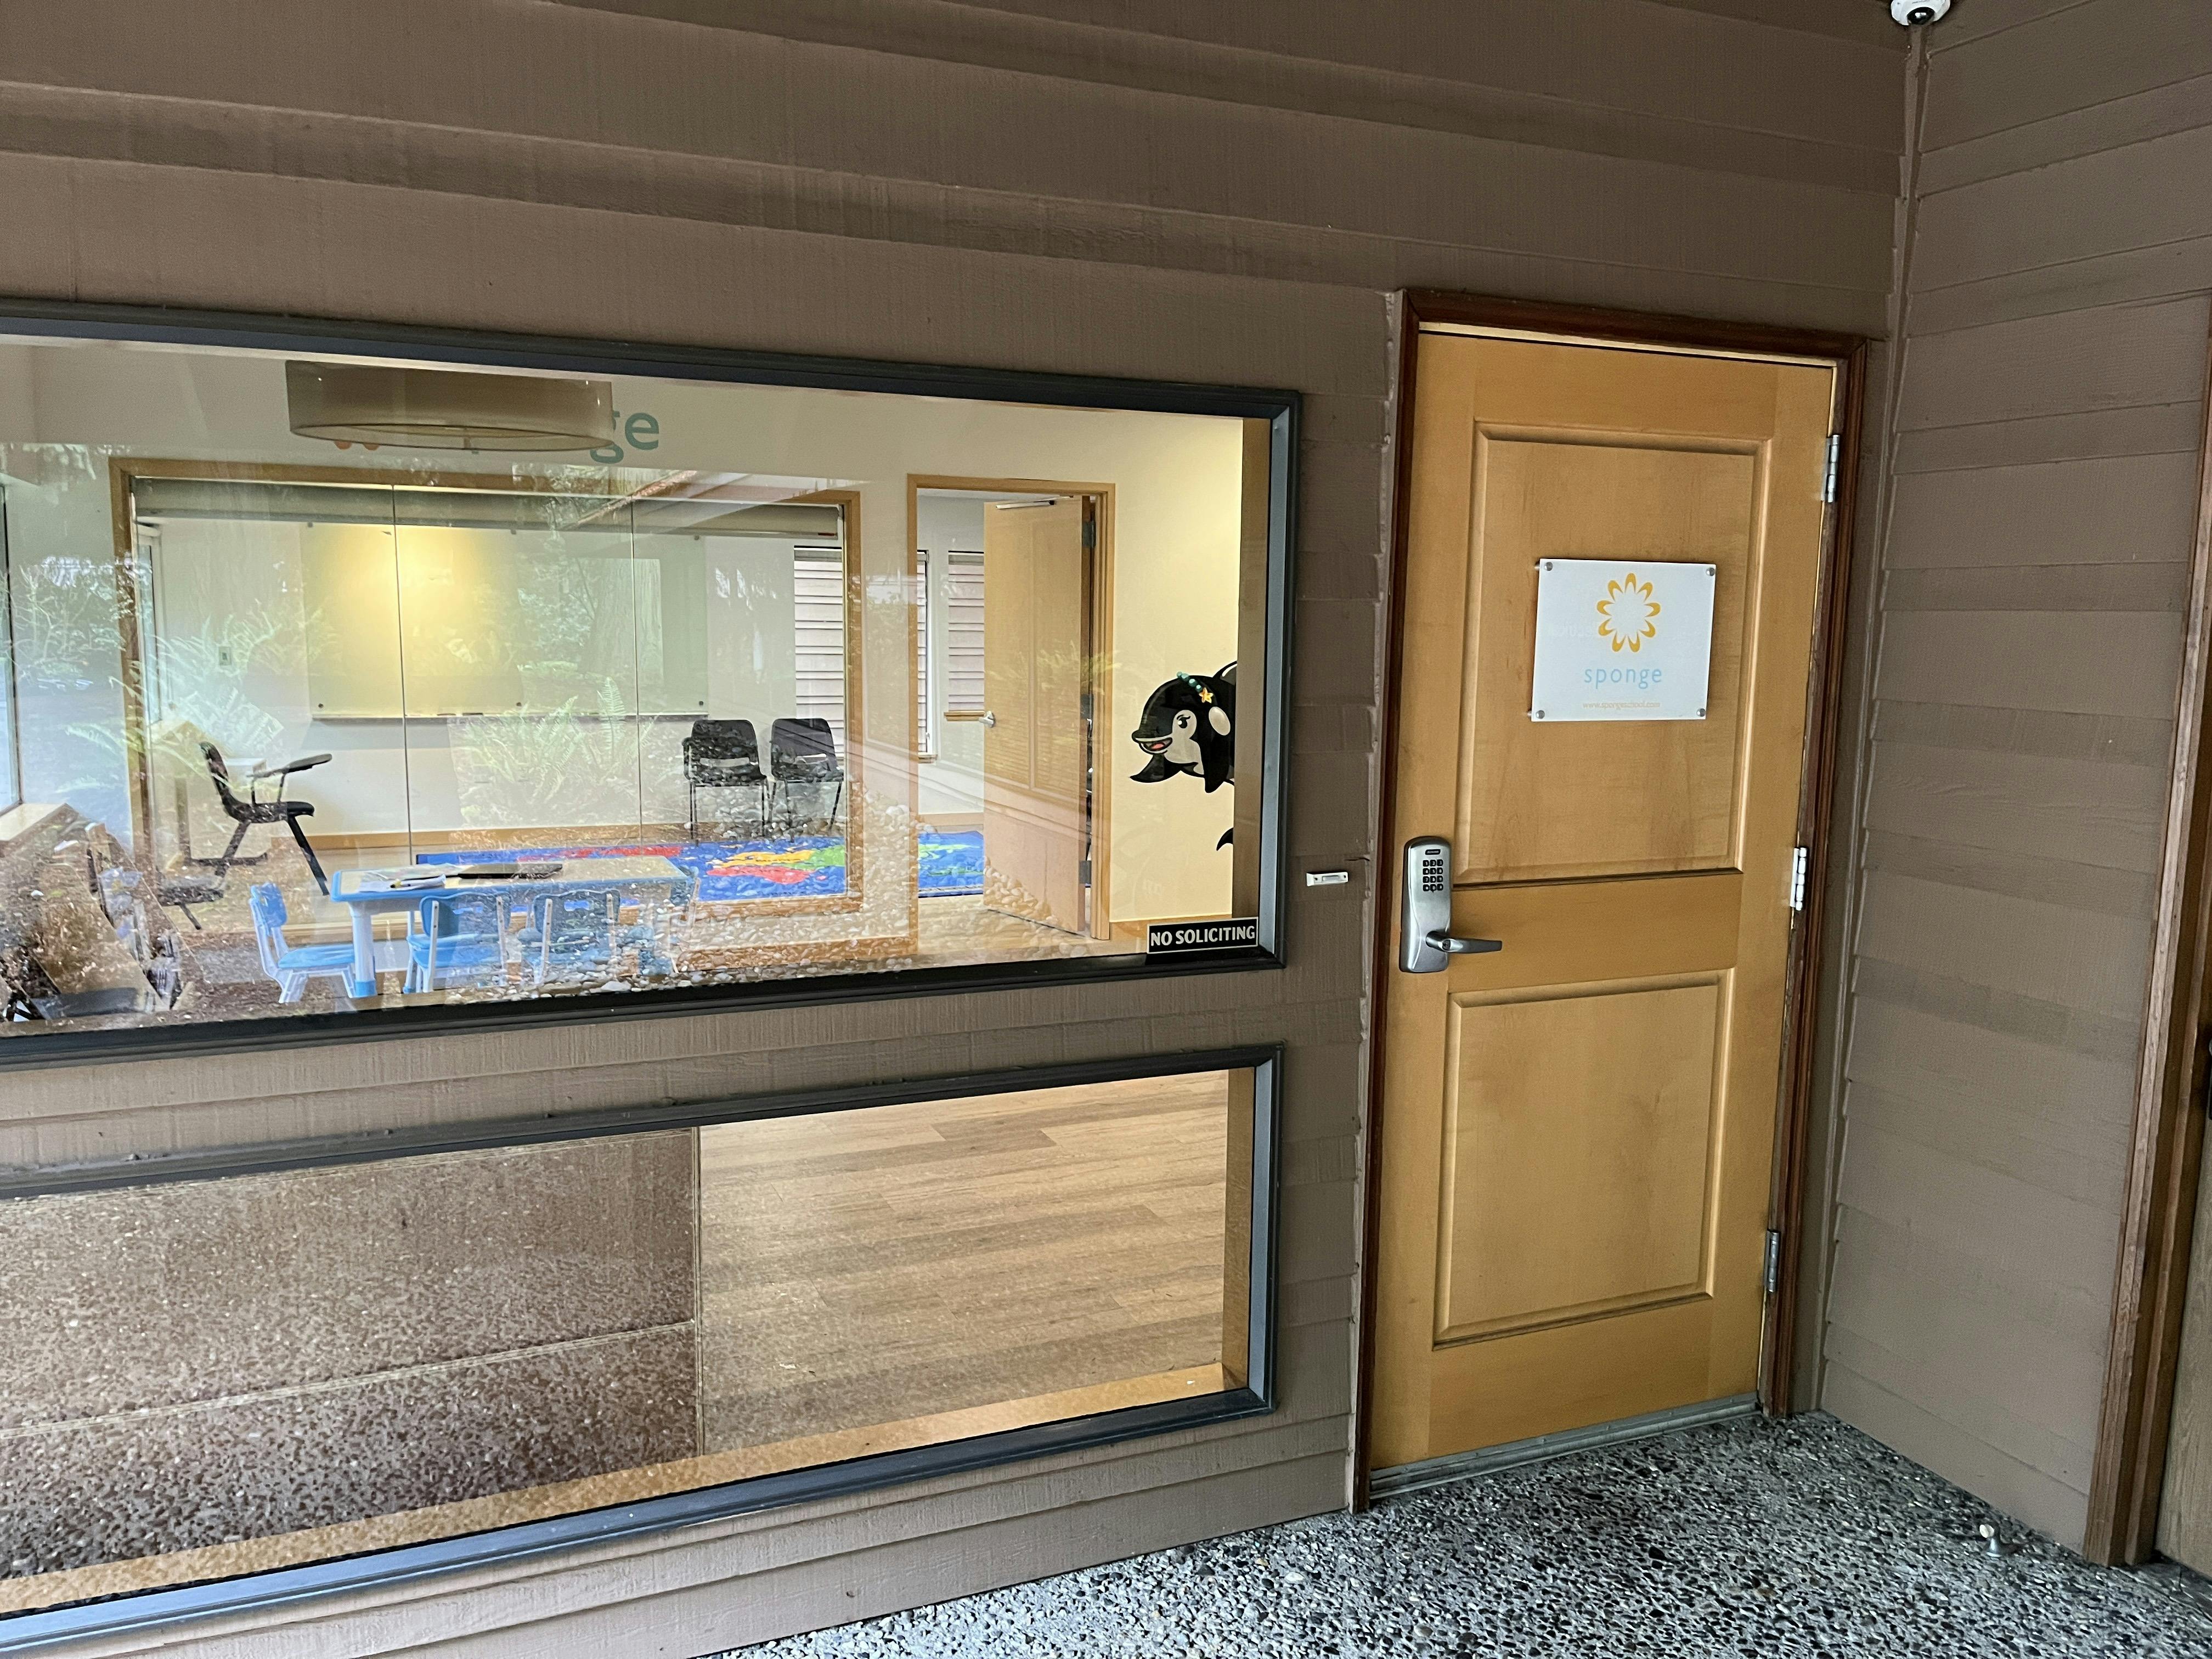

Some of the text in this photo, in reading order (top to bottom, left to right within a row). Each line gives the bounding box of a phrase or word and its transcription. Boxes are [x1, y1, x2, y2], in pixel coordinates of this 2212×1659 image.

[1584, 669, 1662, 689] sponge
[1150, 926, 1255, 946] NO SOLICITING
